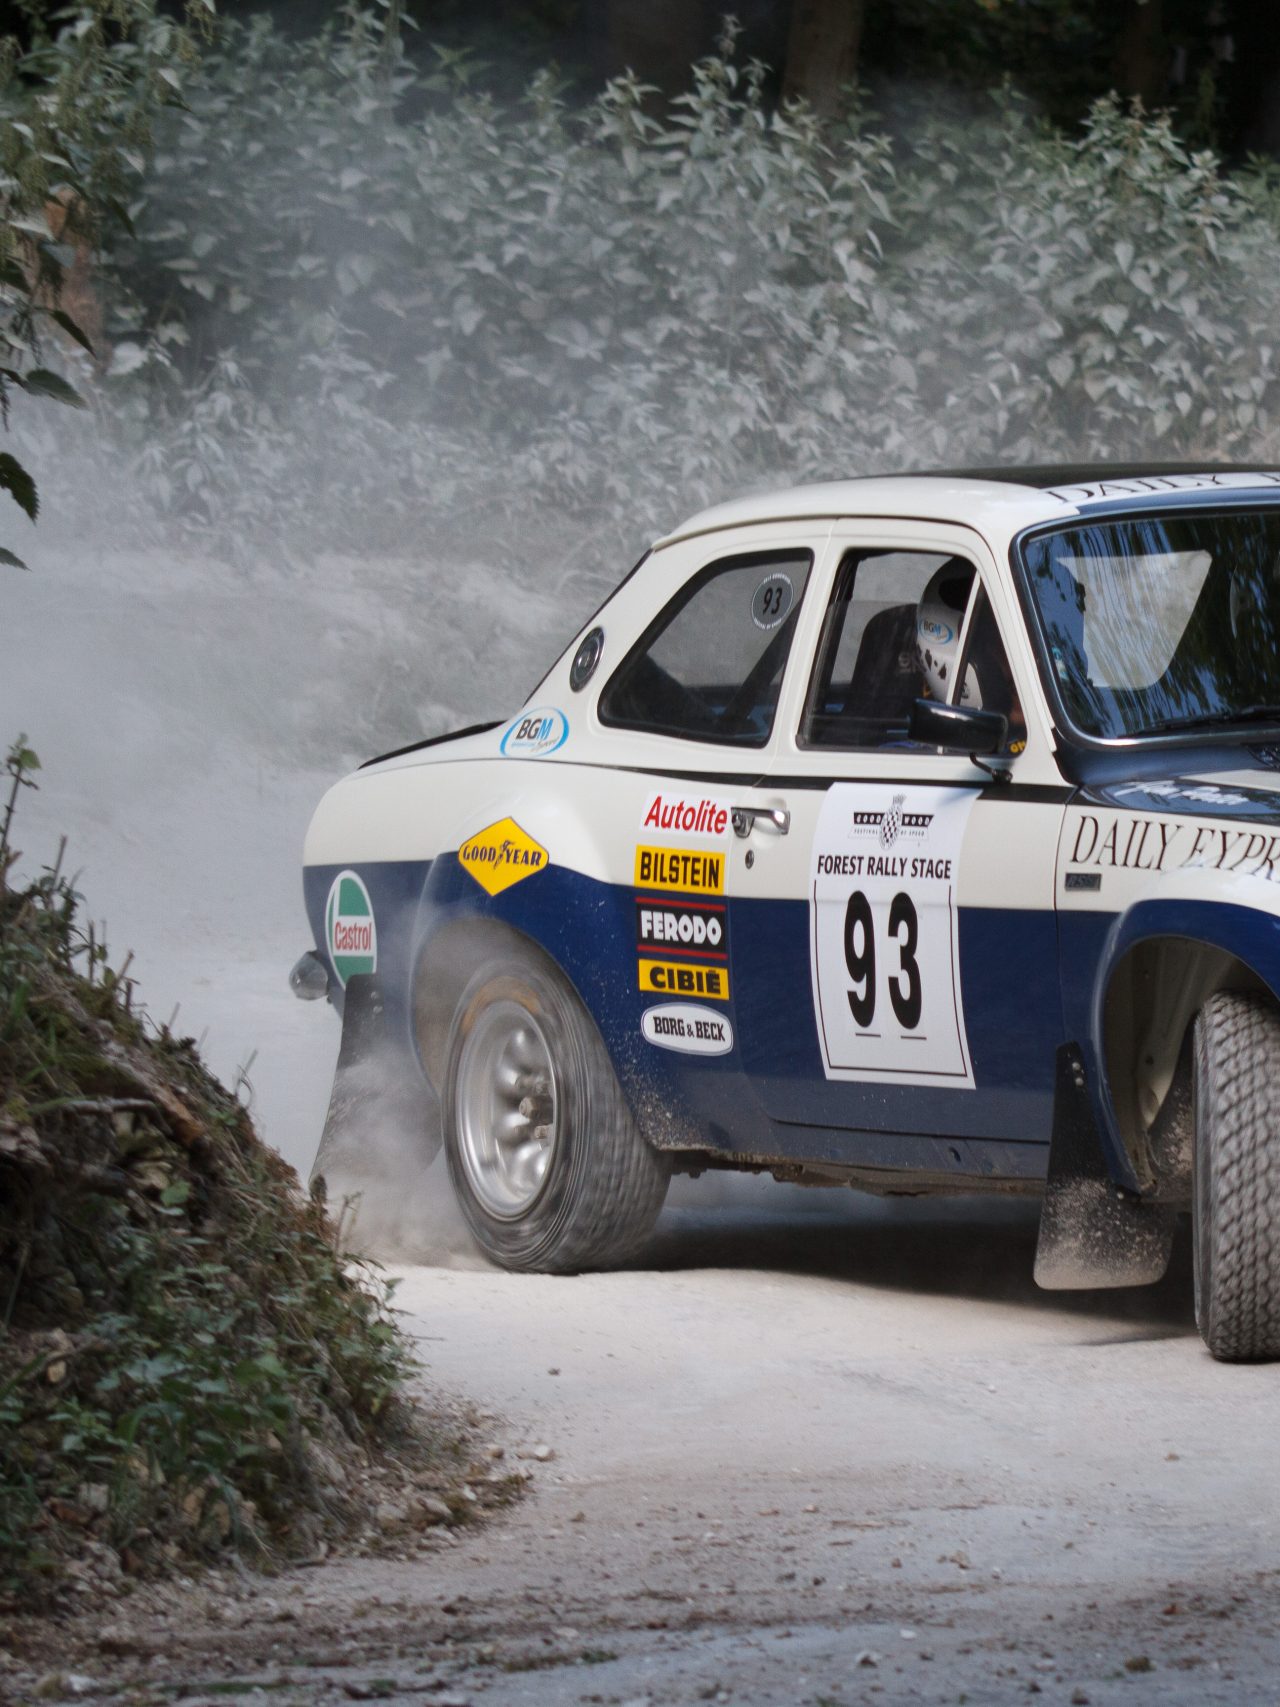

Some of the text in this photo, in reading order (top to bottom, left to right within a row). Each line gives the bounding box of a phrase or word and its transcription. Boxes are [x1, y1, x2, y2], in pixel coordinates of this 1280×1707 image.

[1047, 474, 1228, 503] DAILY
[763, 587, 783, 615] 93
[516, 718, 554, 740] BGM
[644, 795, 728, 834] Autolite
[1070, 815, 1184, 871] DAILY
[640, 851, 720, 889] BILSTEIN
[817, 855, 952, 880] FOREST RALLY STAGE
[334, 921, 372, 951] Castrol
[641, 910, 722, 945] FERODO
[844, 890, 922, 1030] 93
[653, 1015, 726, 1042] BORG & BECK
